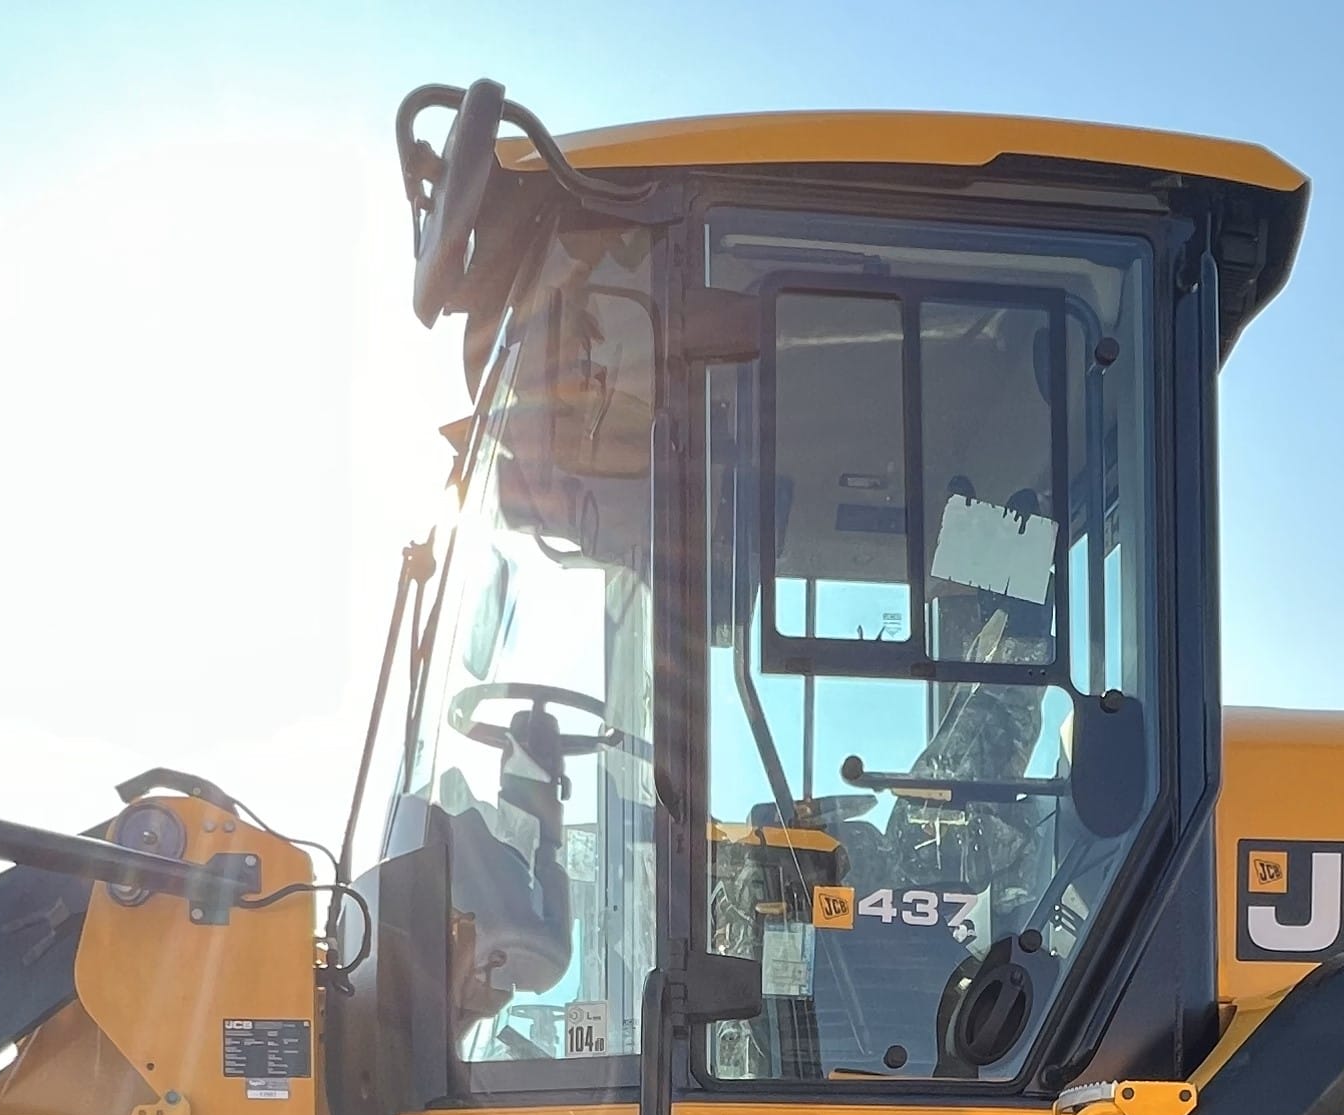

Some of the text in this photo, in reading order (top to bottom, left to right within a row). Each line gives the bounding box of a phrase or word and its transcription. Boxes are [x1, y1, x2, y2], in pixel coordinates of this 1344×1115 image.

[1257, 860, 1283, 884] JCB
[822, 895, 849, 918] JCB
[858, 888, 978, 927] 437
[224, 1020, 253, 1029] JCB
[568, 1026, 594, 1052] 104
